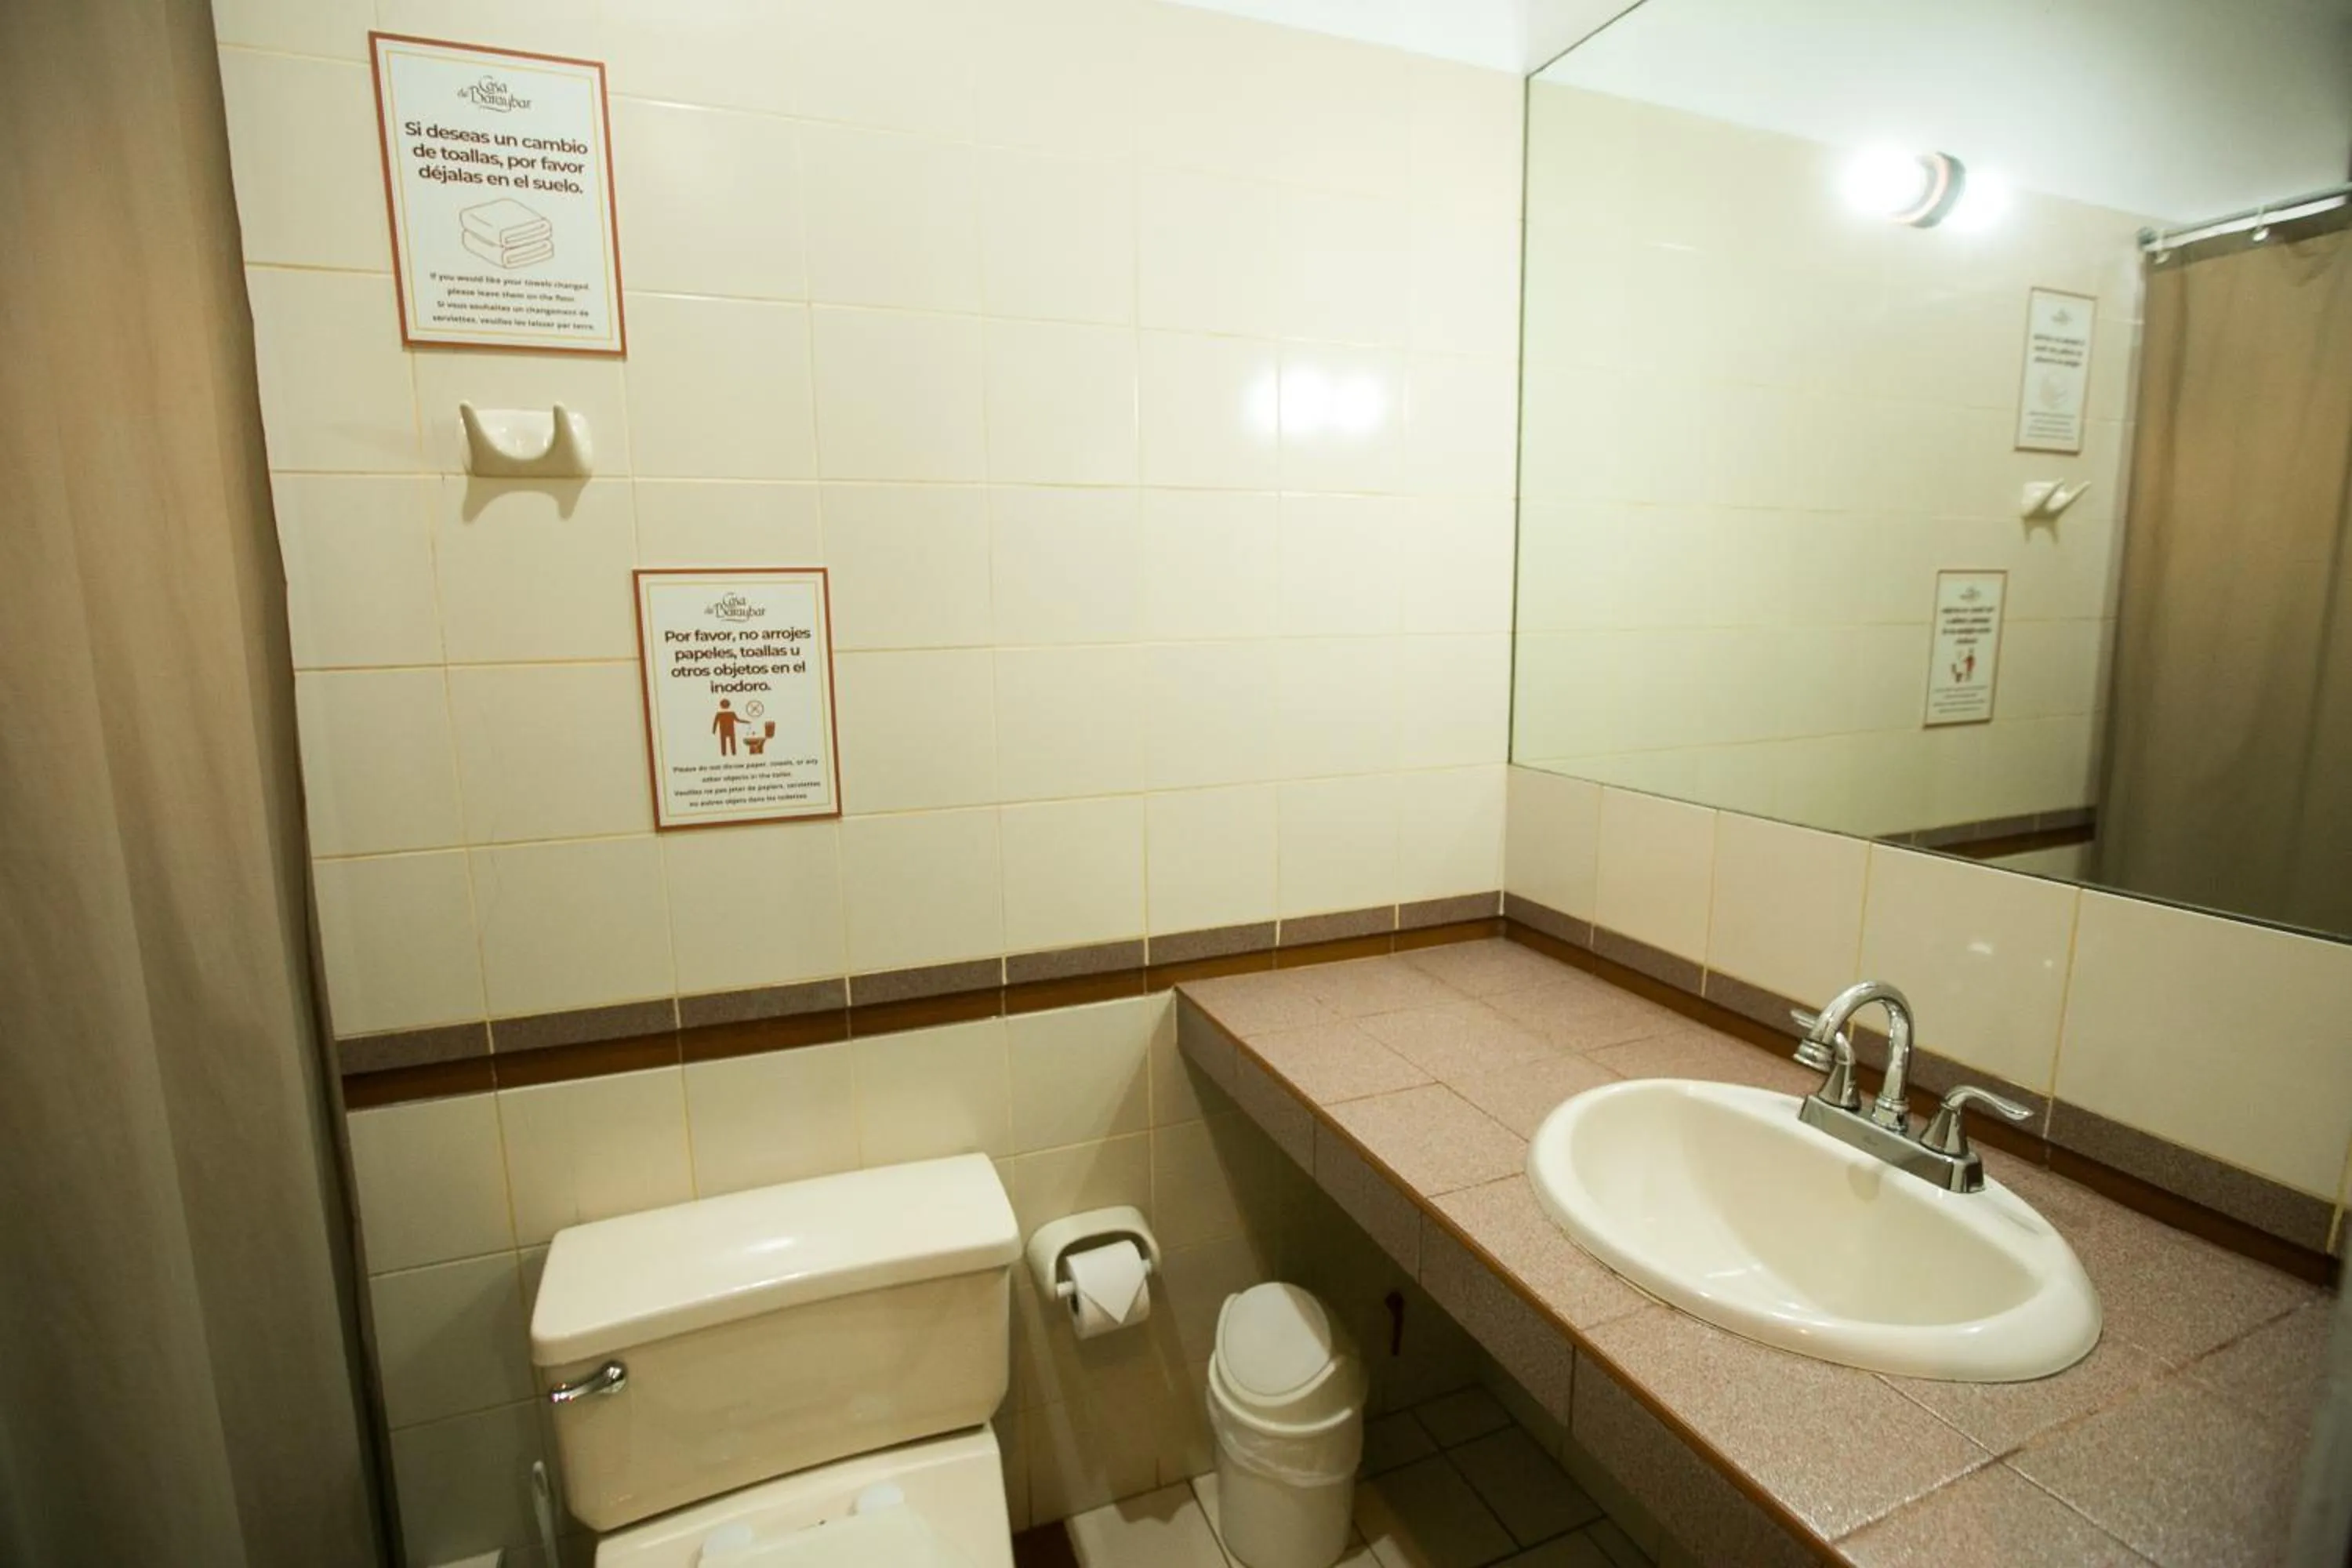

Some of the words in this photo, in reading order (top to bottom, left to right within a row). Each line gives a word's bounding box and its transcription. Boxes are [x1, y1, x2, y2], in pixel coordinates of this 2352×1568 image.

[405, 121, 422, 137] Si
[426, 123, 491, 145] deseas
[494, 134, 518, 147] un
[522, 136, 589, 155] cambio
[412, 143, 437, 159] de
[440, 145, 504, 169] toallas,
[507, 154, 537, 171] por
[541, 156, 586, 176] favor
[418, 164, 483, 185] déjalas
[487, 173, 510, 187] en
[513, 173, 529, 189] el
[532, 176, 584, 194] suelo.
[447, 288, 474, 296] please
[665, 630, 691, 643] Por
[694, 628, 736, 643] favor,
[739, 630, 758, 640] no
[761, 626, 811, 641] arrojes
[674, 647, 738, 663] papeles,
[739, 644, 787, 659] toallas
[789, 647, 800, 656] u
[670, 666, 711, 678] otros
[713, 662, 769, 678] objetos
[771, 662, 790, 673] en
[793, 661, 806, 673] el
[710, 681, 771, 694] inodoro.
